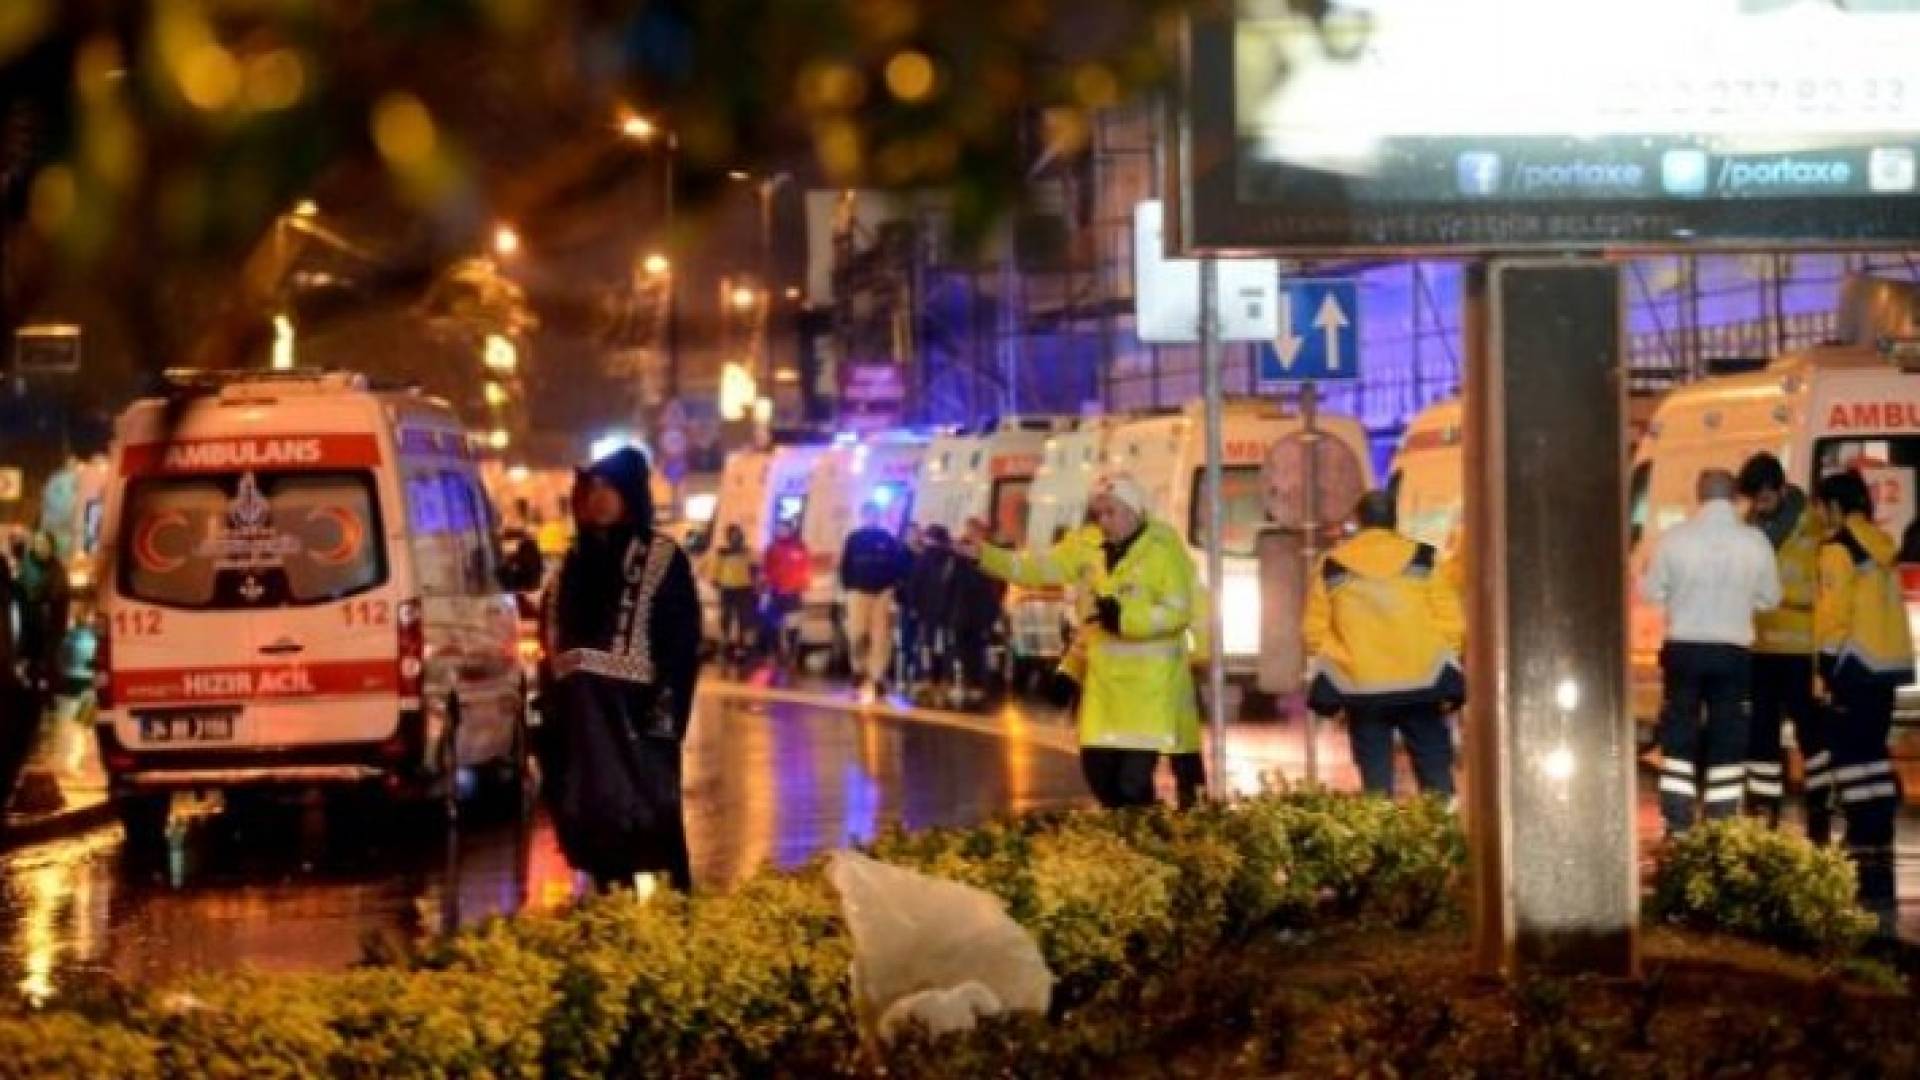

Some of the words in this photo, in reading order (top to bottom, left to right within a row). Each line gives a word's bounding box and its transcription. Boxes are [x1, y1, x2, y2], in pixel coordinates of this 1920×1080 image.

[1717, 157, 1852, 189] /portaxe
[165, 439, 322, 468] AMBULANS
[115, 609, 163, 635] 112
[341, 600, 390, 626] 112
[182, 671, 252, 697] HIZIR
